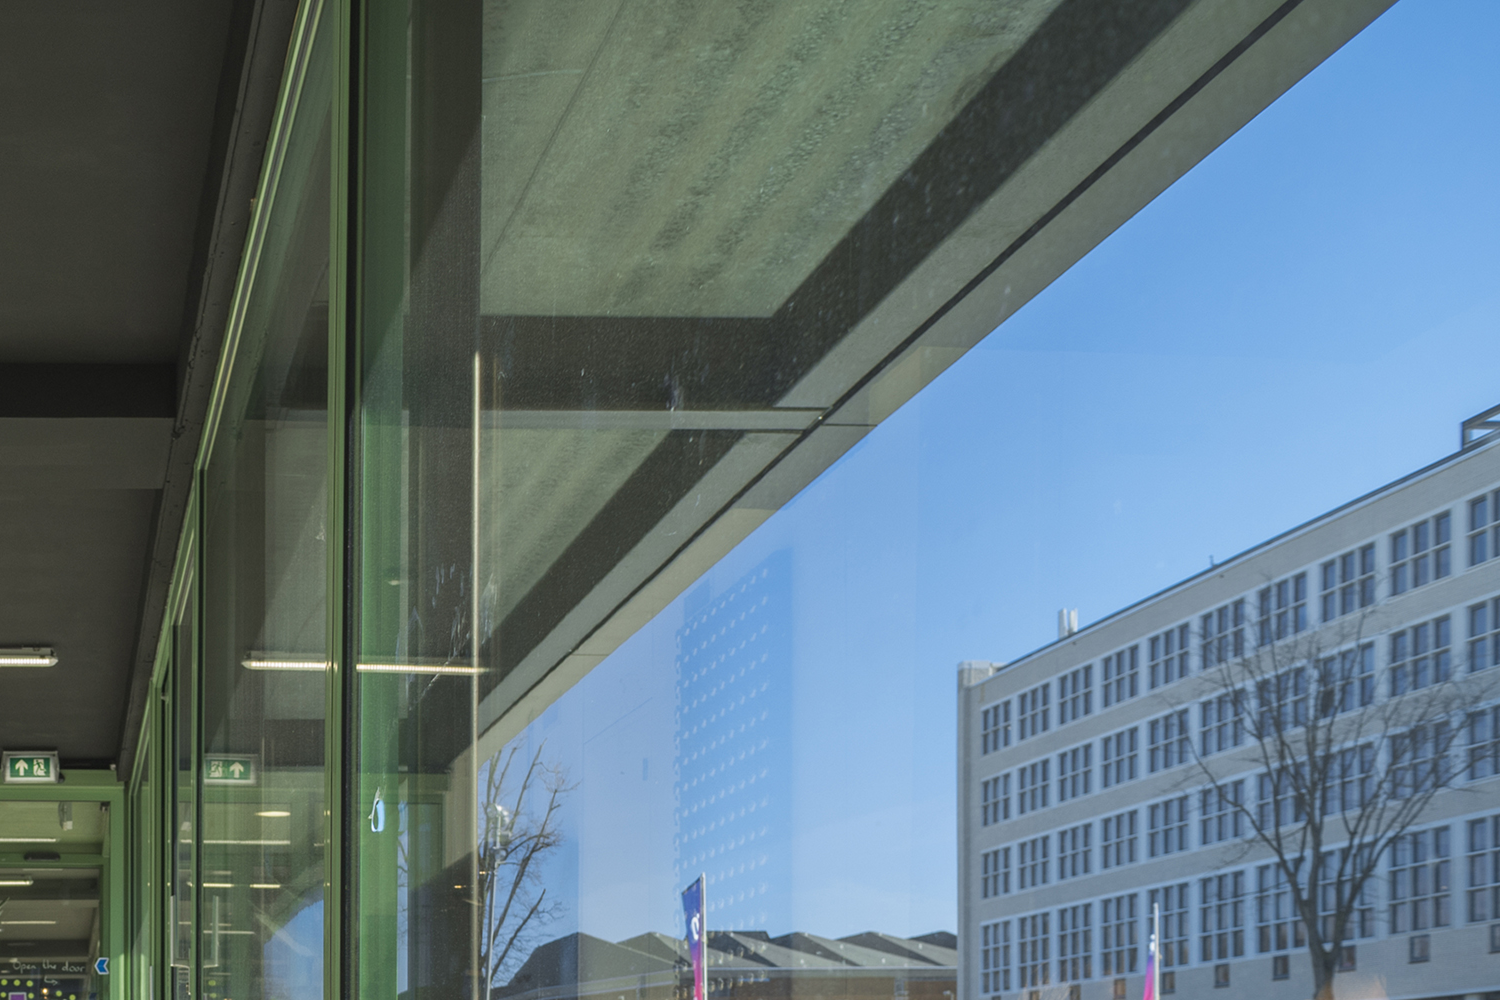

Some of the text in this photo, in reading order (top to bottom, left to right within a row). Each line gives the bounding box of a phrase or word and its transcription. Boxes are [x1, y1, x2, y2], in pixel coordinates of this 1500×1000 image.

[13, 959, 86, 974] Open the door
